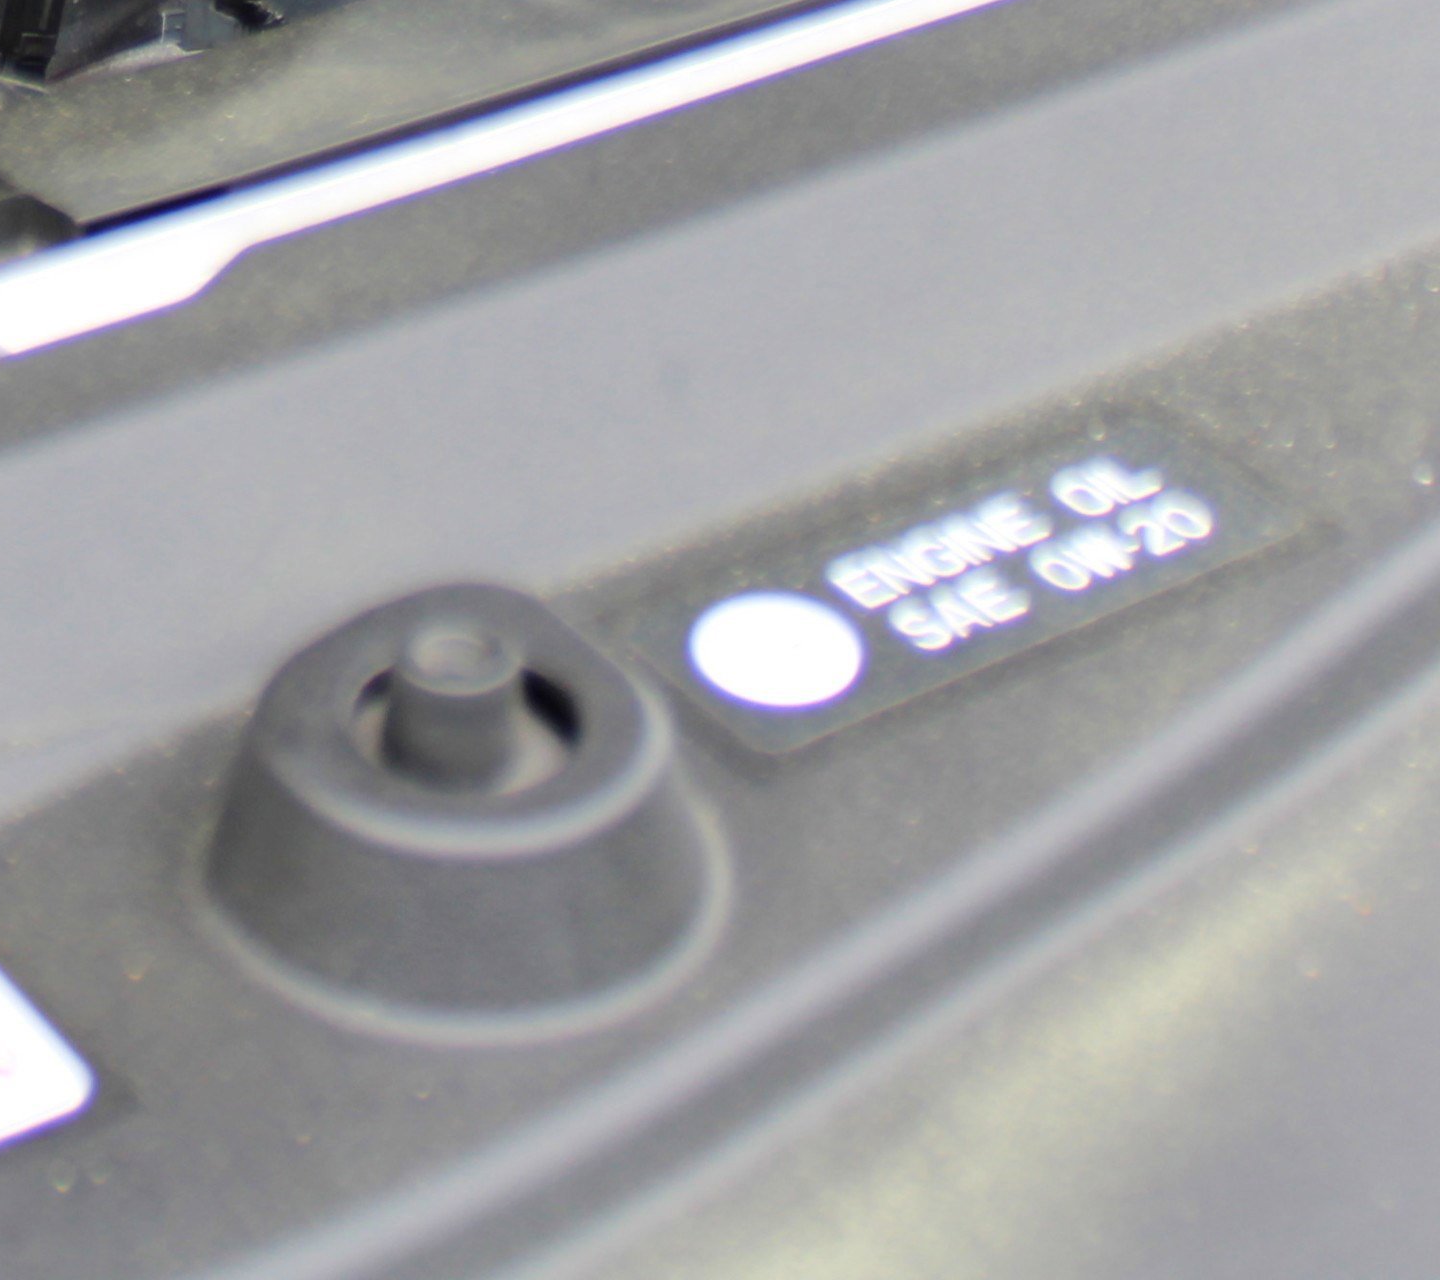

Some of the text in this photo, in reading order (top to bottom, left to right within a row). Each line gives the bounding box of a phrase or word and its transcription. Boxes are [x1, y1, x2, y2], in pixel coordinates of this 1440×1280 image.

[826, 458, 1163, 610] ENGINE OIL
[887, 490, 1214, 651] SAE 0W-20
